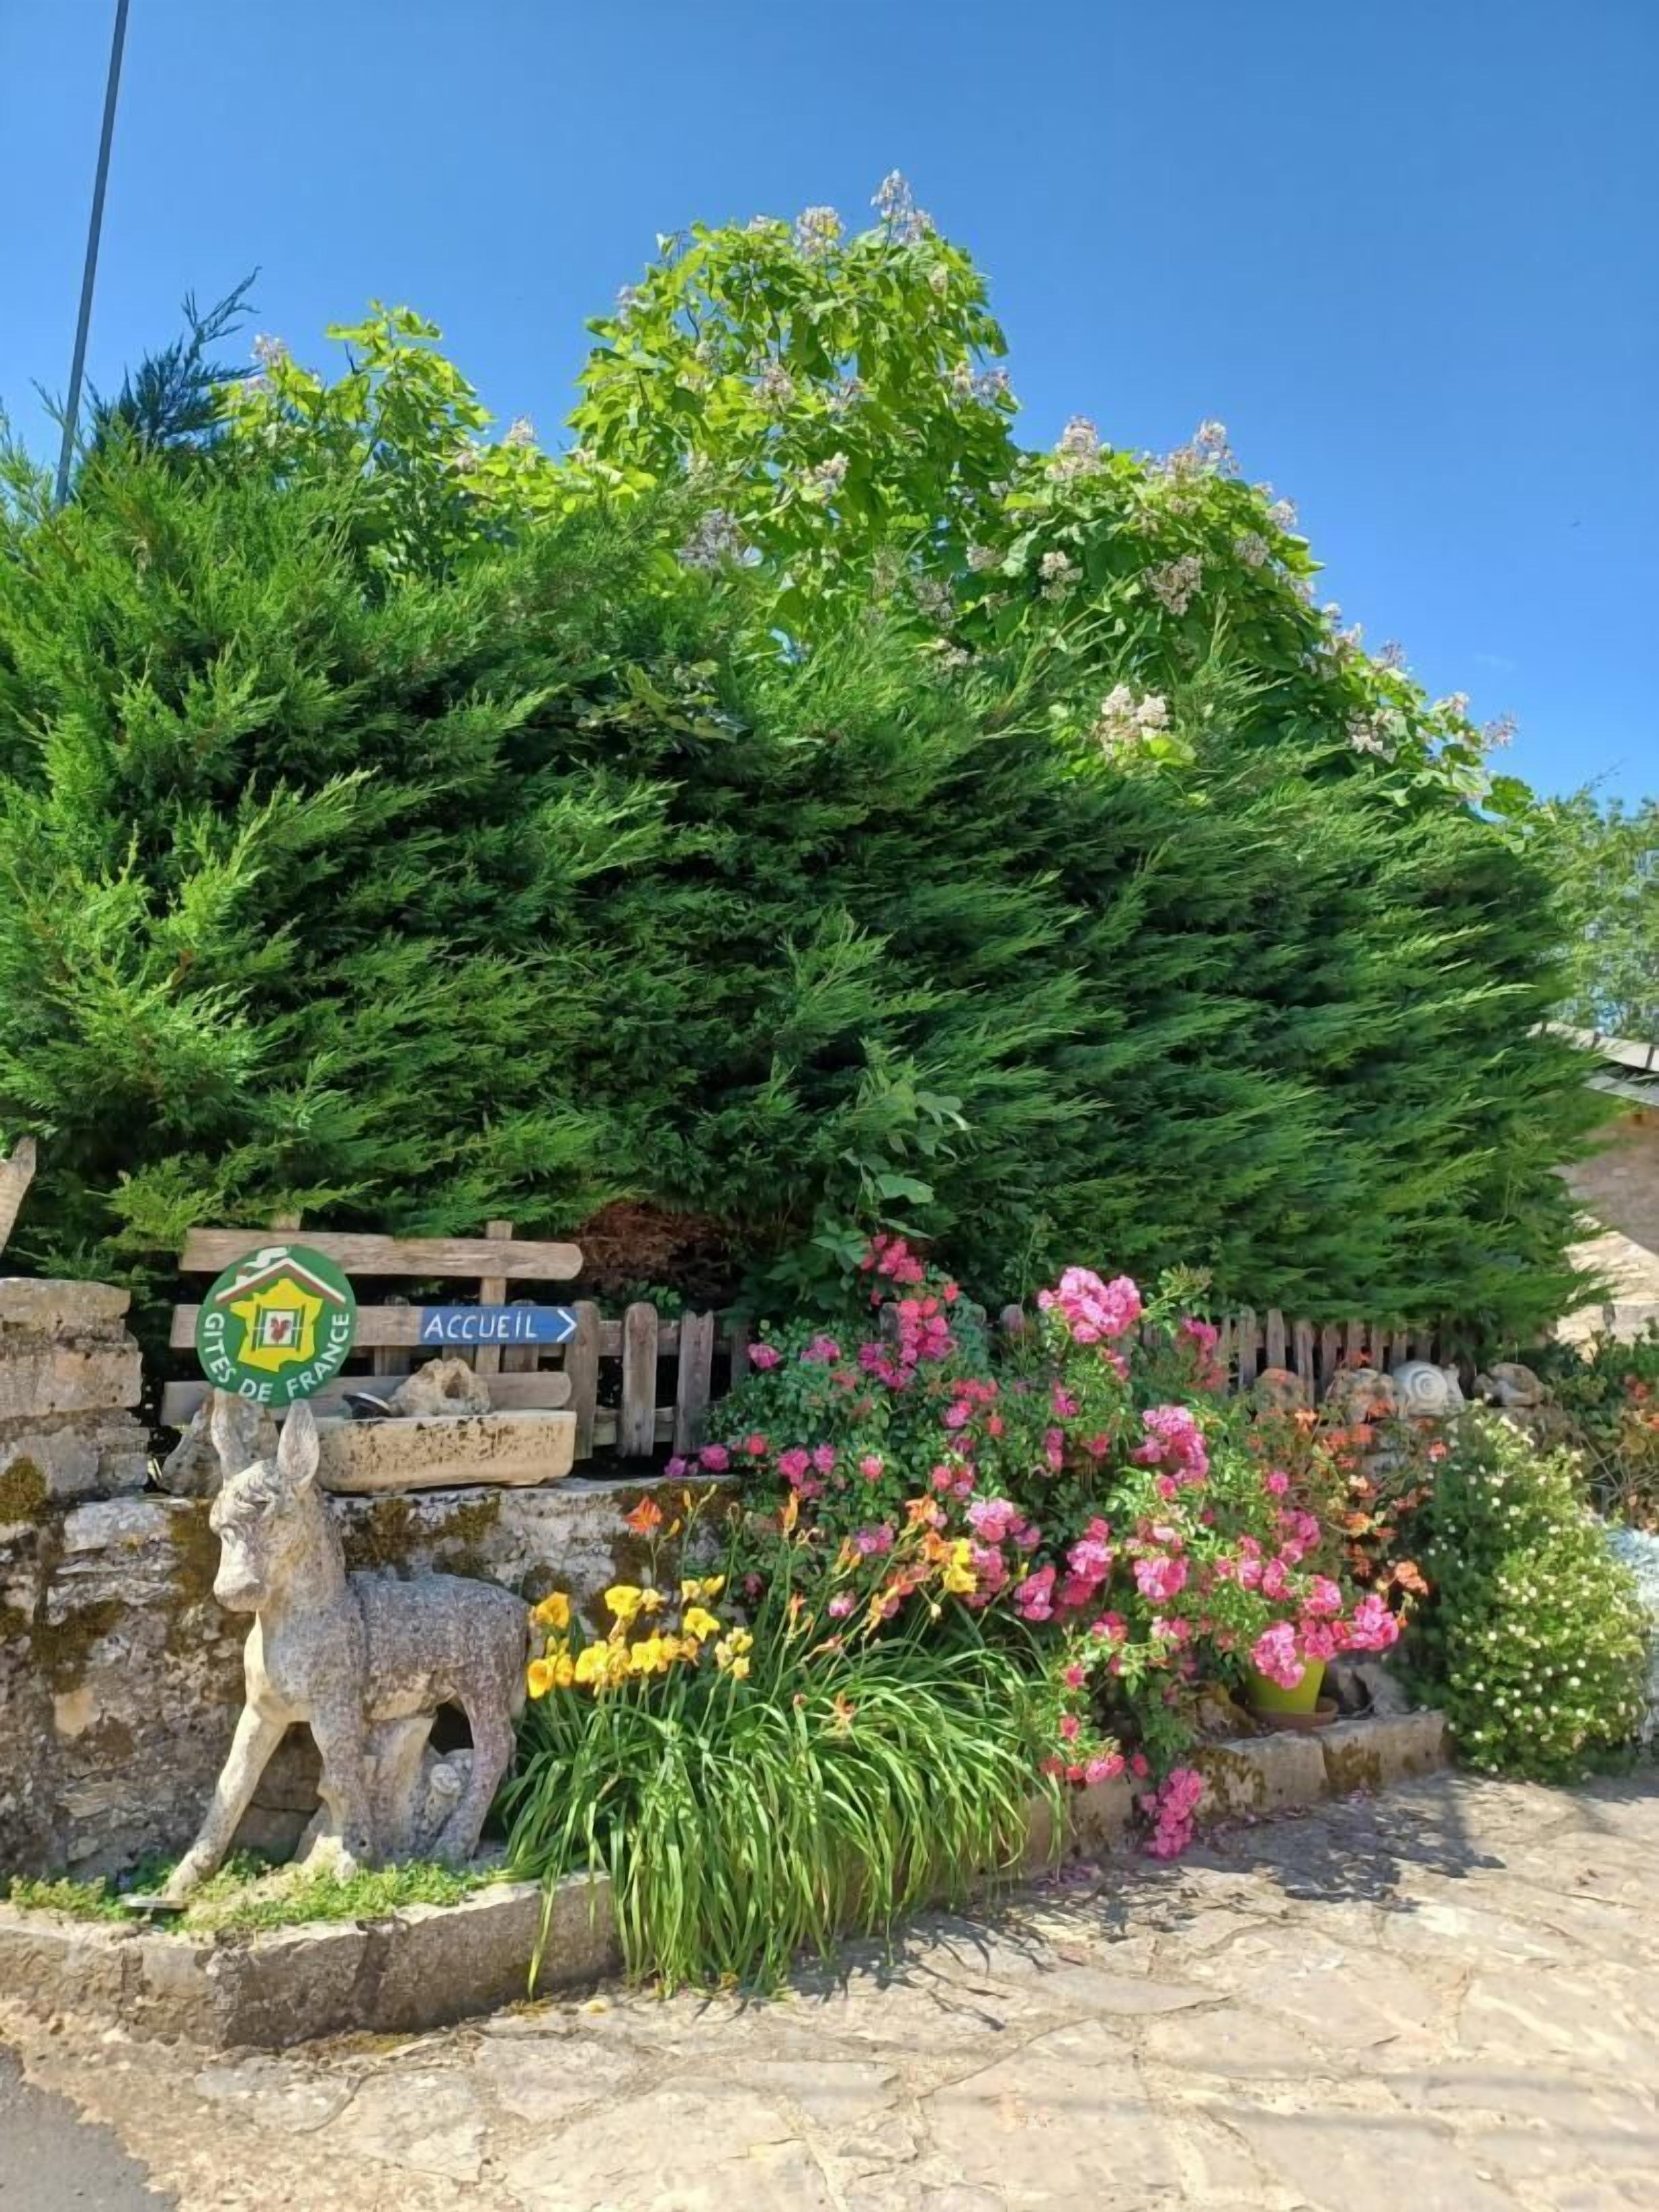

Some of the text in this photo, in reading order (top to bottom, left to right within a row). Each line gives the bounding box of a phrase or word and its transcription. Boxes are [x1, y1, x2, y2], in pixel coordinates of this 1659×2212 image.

[423, 1310, 538, 1339] ACCUEIL
[203, 1312, 350, 1402] GITES DE FRANCE
